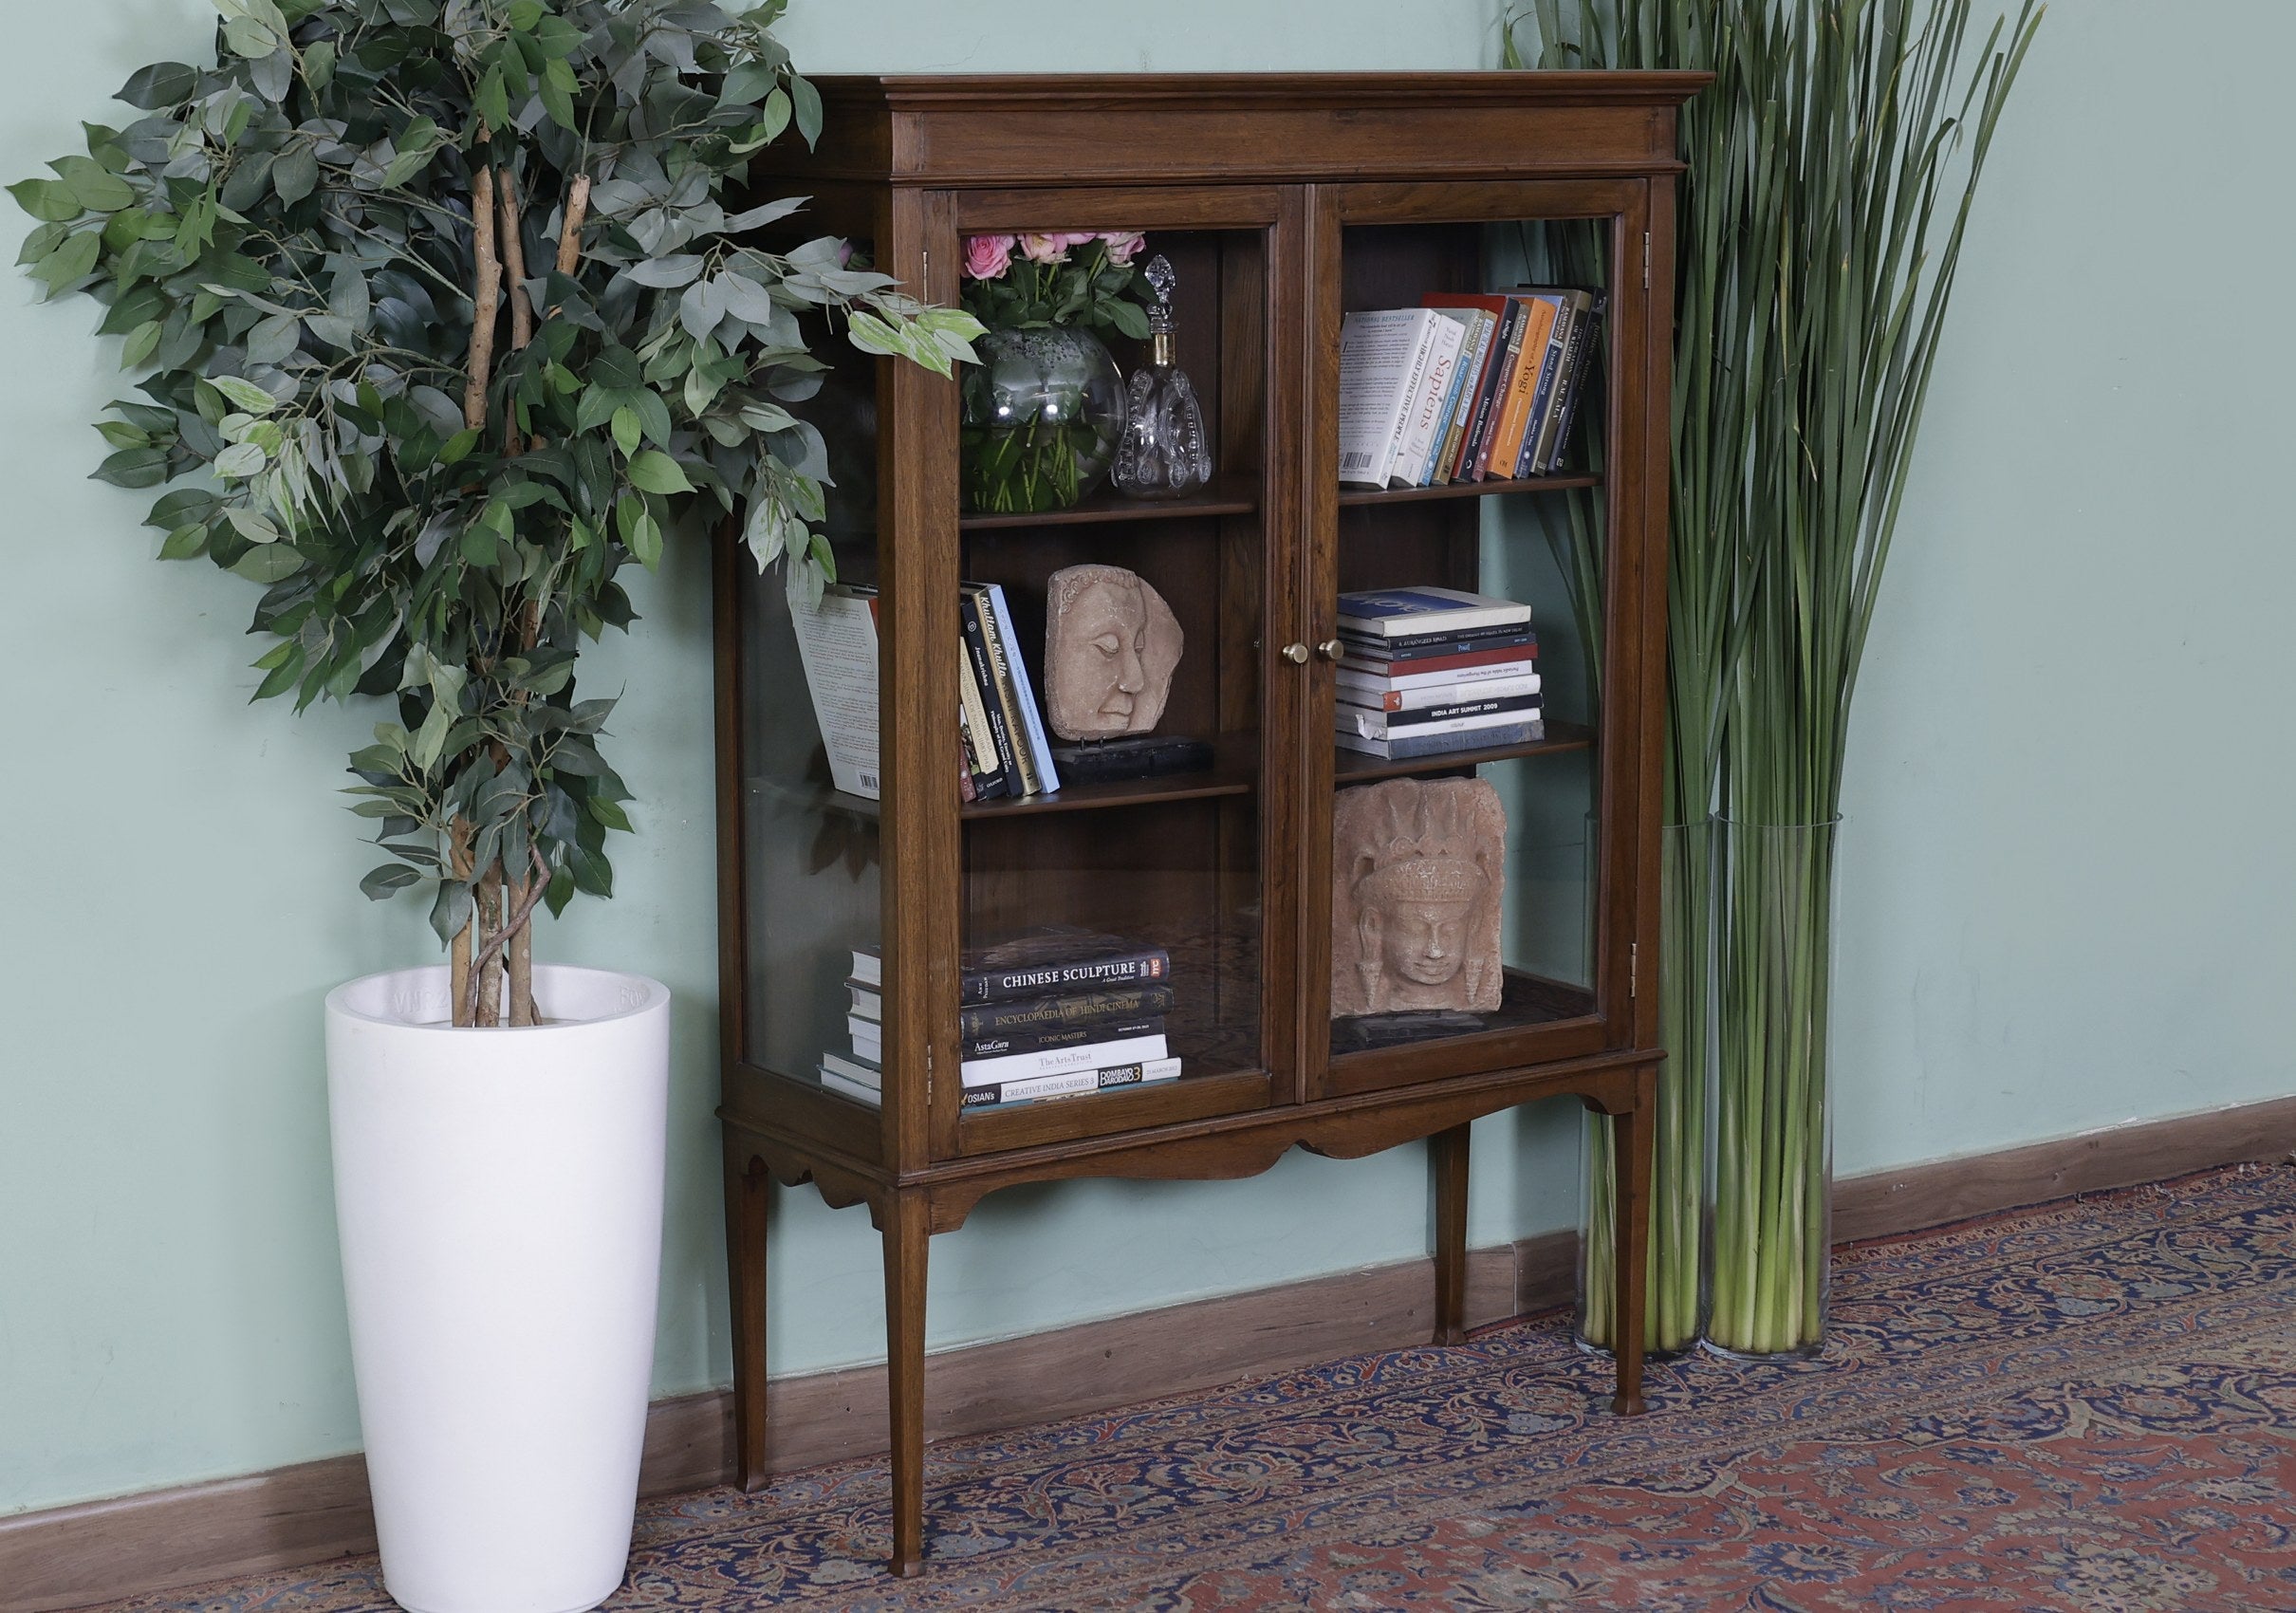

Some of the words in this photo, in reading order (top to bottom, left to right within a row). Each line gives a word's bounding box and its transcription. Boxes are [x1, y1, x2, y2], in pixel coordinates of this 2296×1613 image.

[1381, 314, 1416, 323] BESTSELLER
[1427, 318, 1435, 327] 7
[1514, 314, 1527, 345] RAMAYANA
[1530, 309, 1547, 352] Autobiography
[1557, 306, 1570, 339] RAMAYANA
[1478, 322, 1493, 350] PRACTICAL
[1565, 335, 1576, 362] WEALTH
[1414, 343, 1428, 371] HIGHLY
[1458, 360, 1469, 375] Roar
[1501, 353, 1515, 383] Conquer
[1546, 349, 1557, 370] Stand
[1401, 370, 1419, 412] EFFECTIVE
[1515, 362, 1535, 395] Yogi
[1539, 370, 1551, 396] Strong
[1419, 355, 1452, 430] Sapiens
[1493, 382, 1507, 409] Change
[1441, 394, 1456, 425] Courage
[1478, 396, 1491, 418] Miriam
[1552, 398, 1563, 418] LALA
[1393, 411, 1407, 440] PEOPLE
[978, 595, 998, 641] Khullam
[991, 640, 1009, 678] Khulla
[972, 645, 991, 686] Jnanakrishna
[963, 682, 972, 702] SINGH
[971, 714, 981, 736] NABHA
[1001, 680, 1016, 712] RISHI
[1009, 713, 1028, 765] KAPOOR
[1460, 705, 1481, 714] SUMMIT
[1003, 971, 1059, 988] CHINESE
[1063, 961, 1136, 981] SCULPTURE
[995, 1010, 1063, 1026] ENCYCLOPAEDIA
[1065, 1007, 1077, 1016] OF
[1082, 1004, 1104, 1014] HINDI
[1106, 1000, 1139, 1011] CINEMA
[974, 1040, 1009, 1051] AstaGuru
[1039, 1034, 1061, 1044] ICONIC
[1062, 1031, 1087, 1041] MASTERS
[1134, 1066, 1141, 1081] 3
[968, 1092, 995, 1103] OSIAN's
[1005, 1085, 1042, 1098] CREATIVE
[1044, 1082, 1065, 1091] INDIA
[1065, 1077, 1088, 1088] SERIES
[1088, 1077, 1095, 1085] 3
